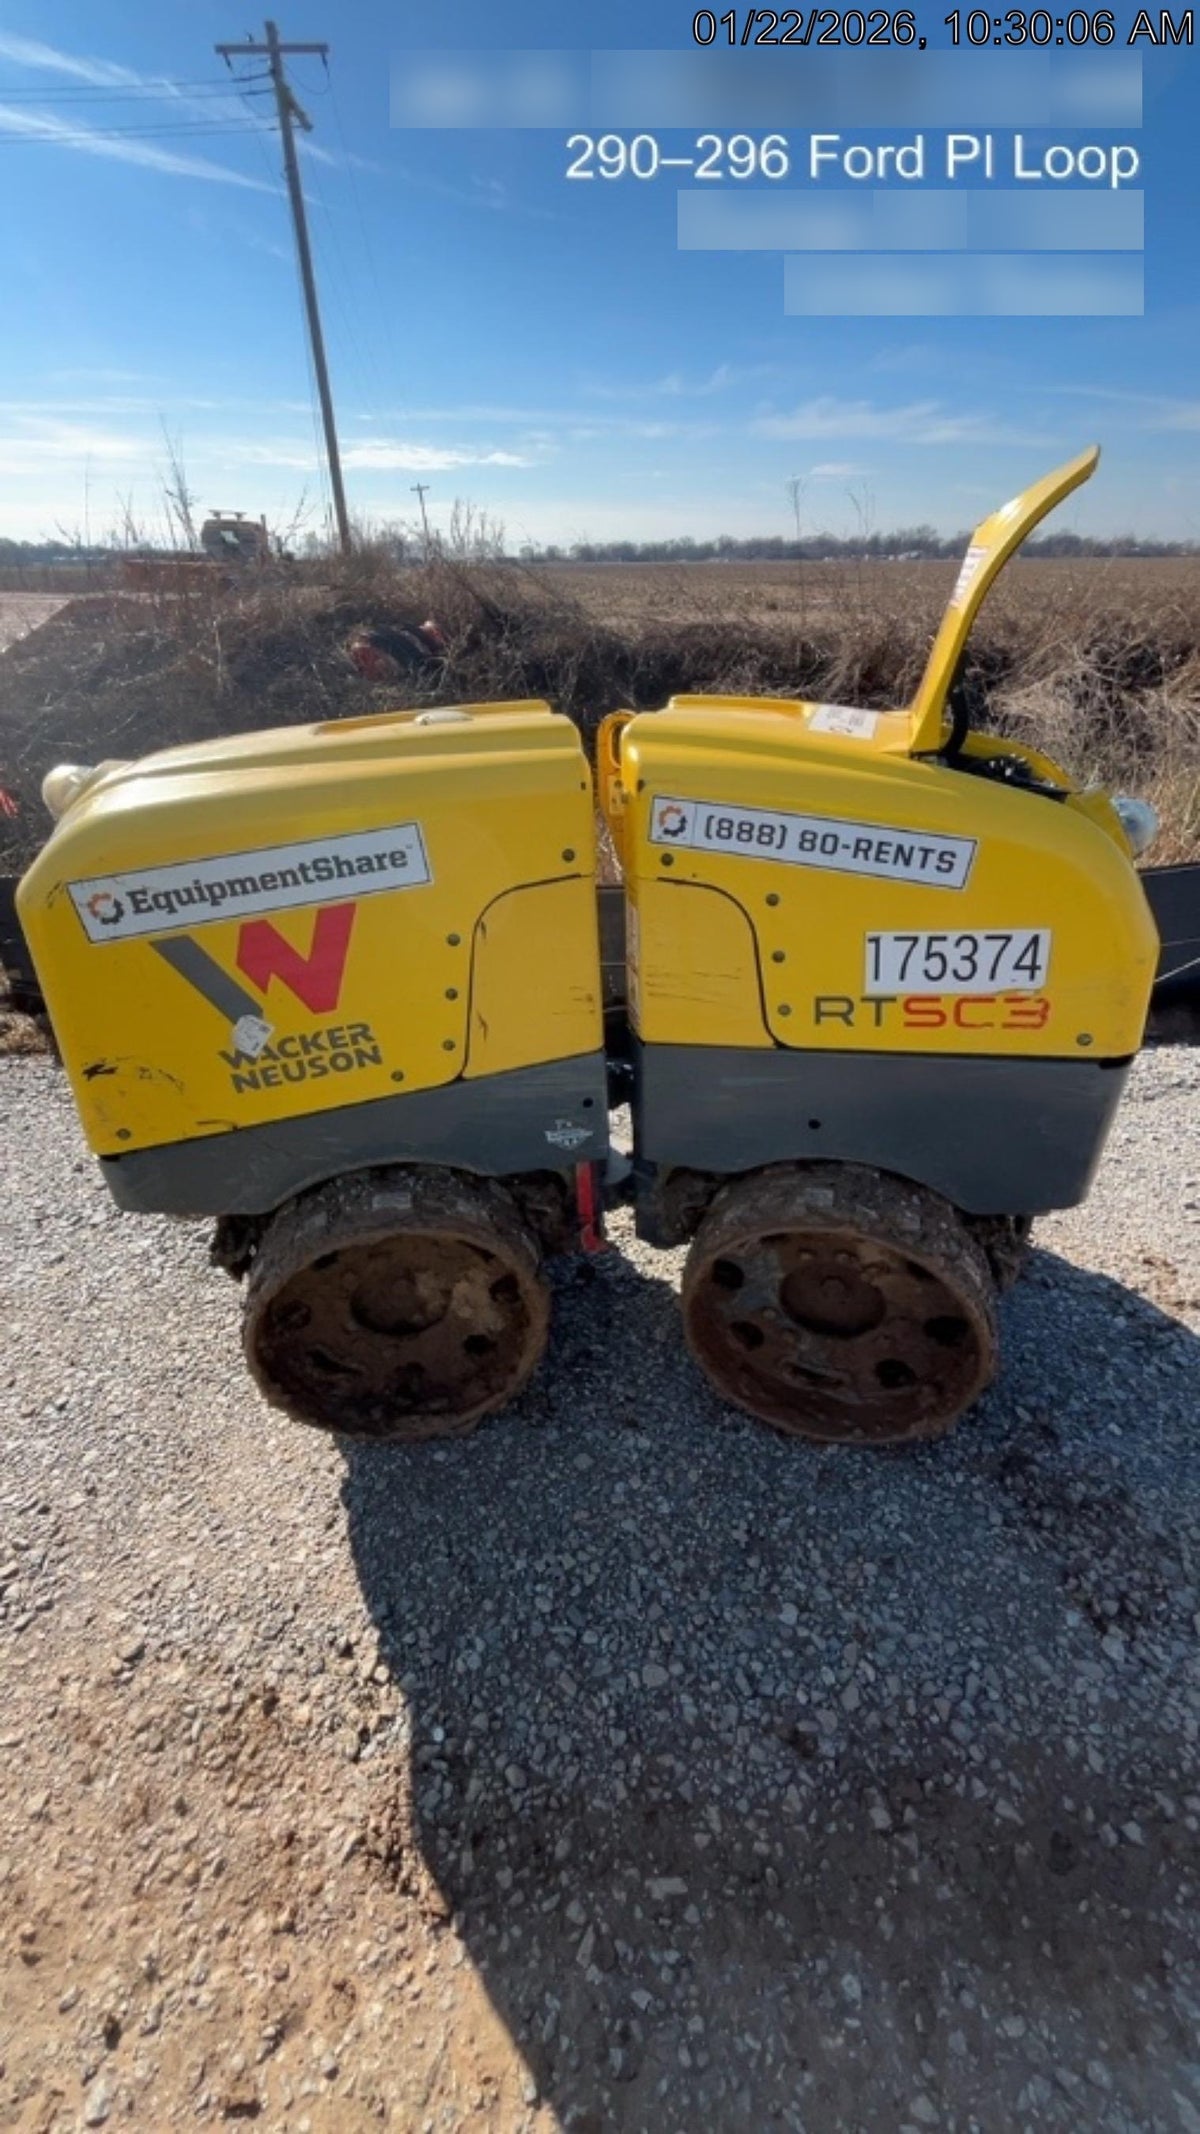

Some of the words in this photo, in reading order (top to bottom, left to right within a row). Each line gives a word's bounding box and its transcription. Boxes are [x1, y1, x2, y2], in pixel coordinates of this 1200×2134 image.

[704, 815, 788, 849] (888)
[798, 830, 957, 874] 80-RENTS
[867, 934, 1042, 982] 175374
[230, 1045, 383, 1094] NEUSON
